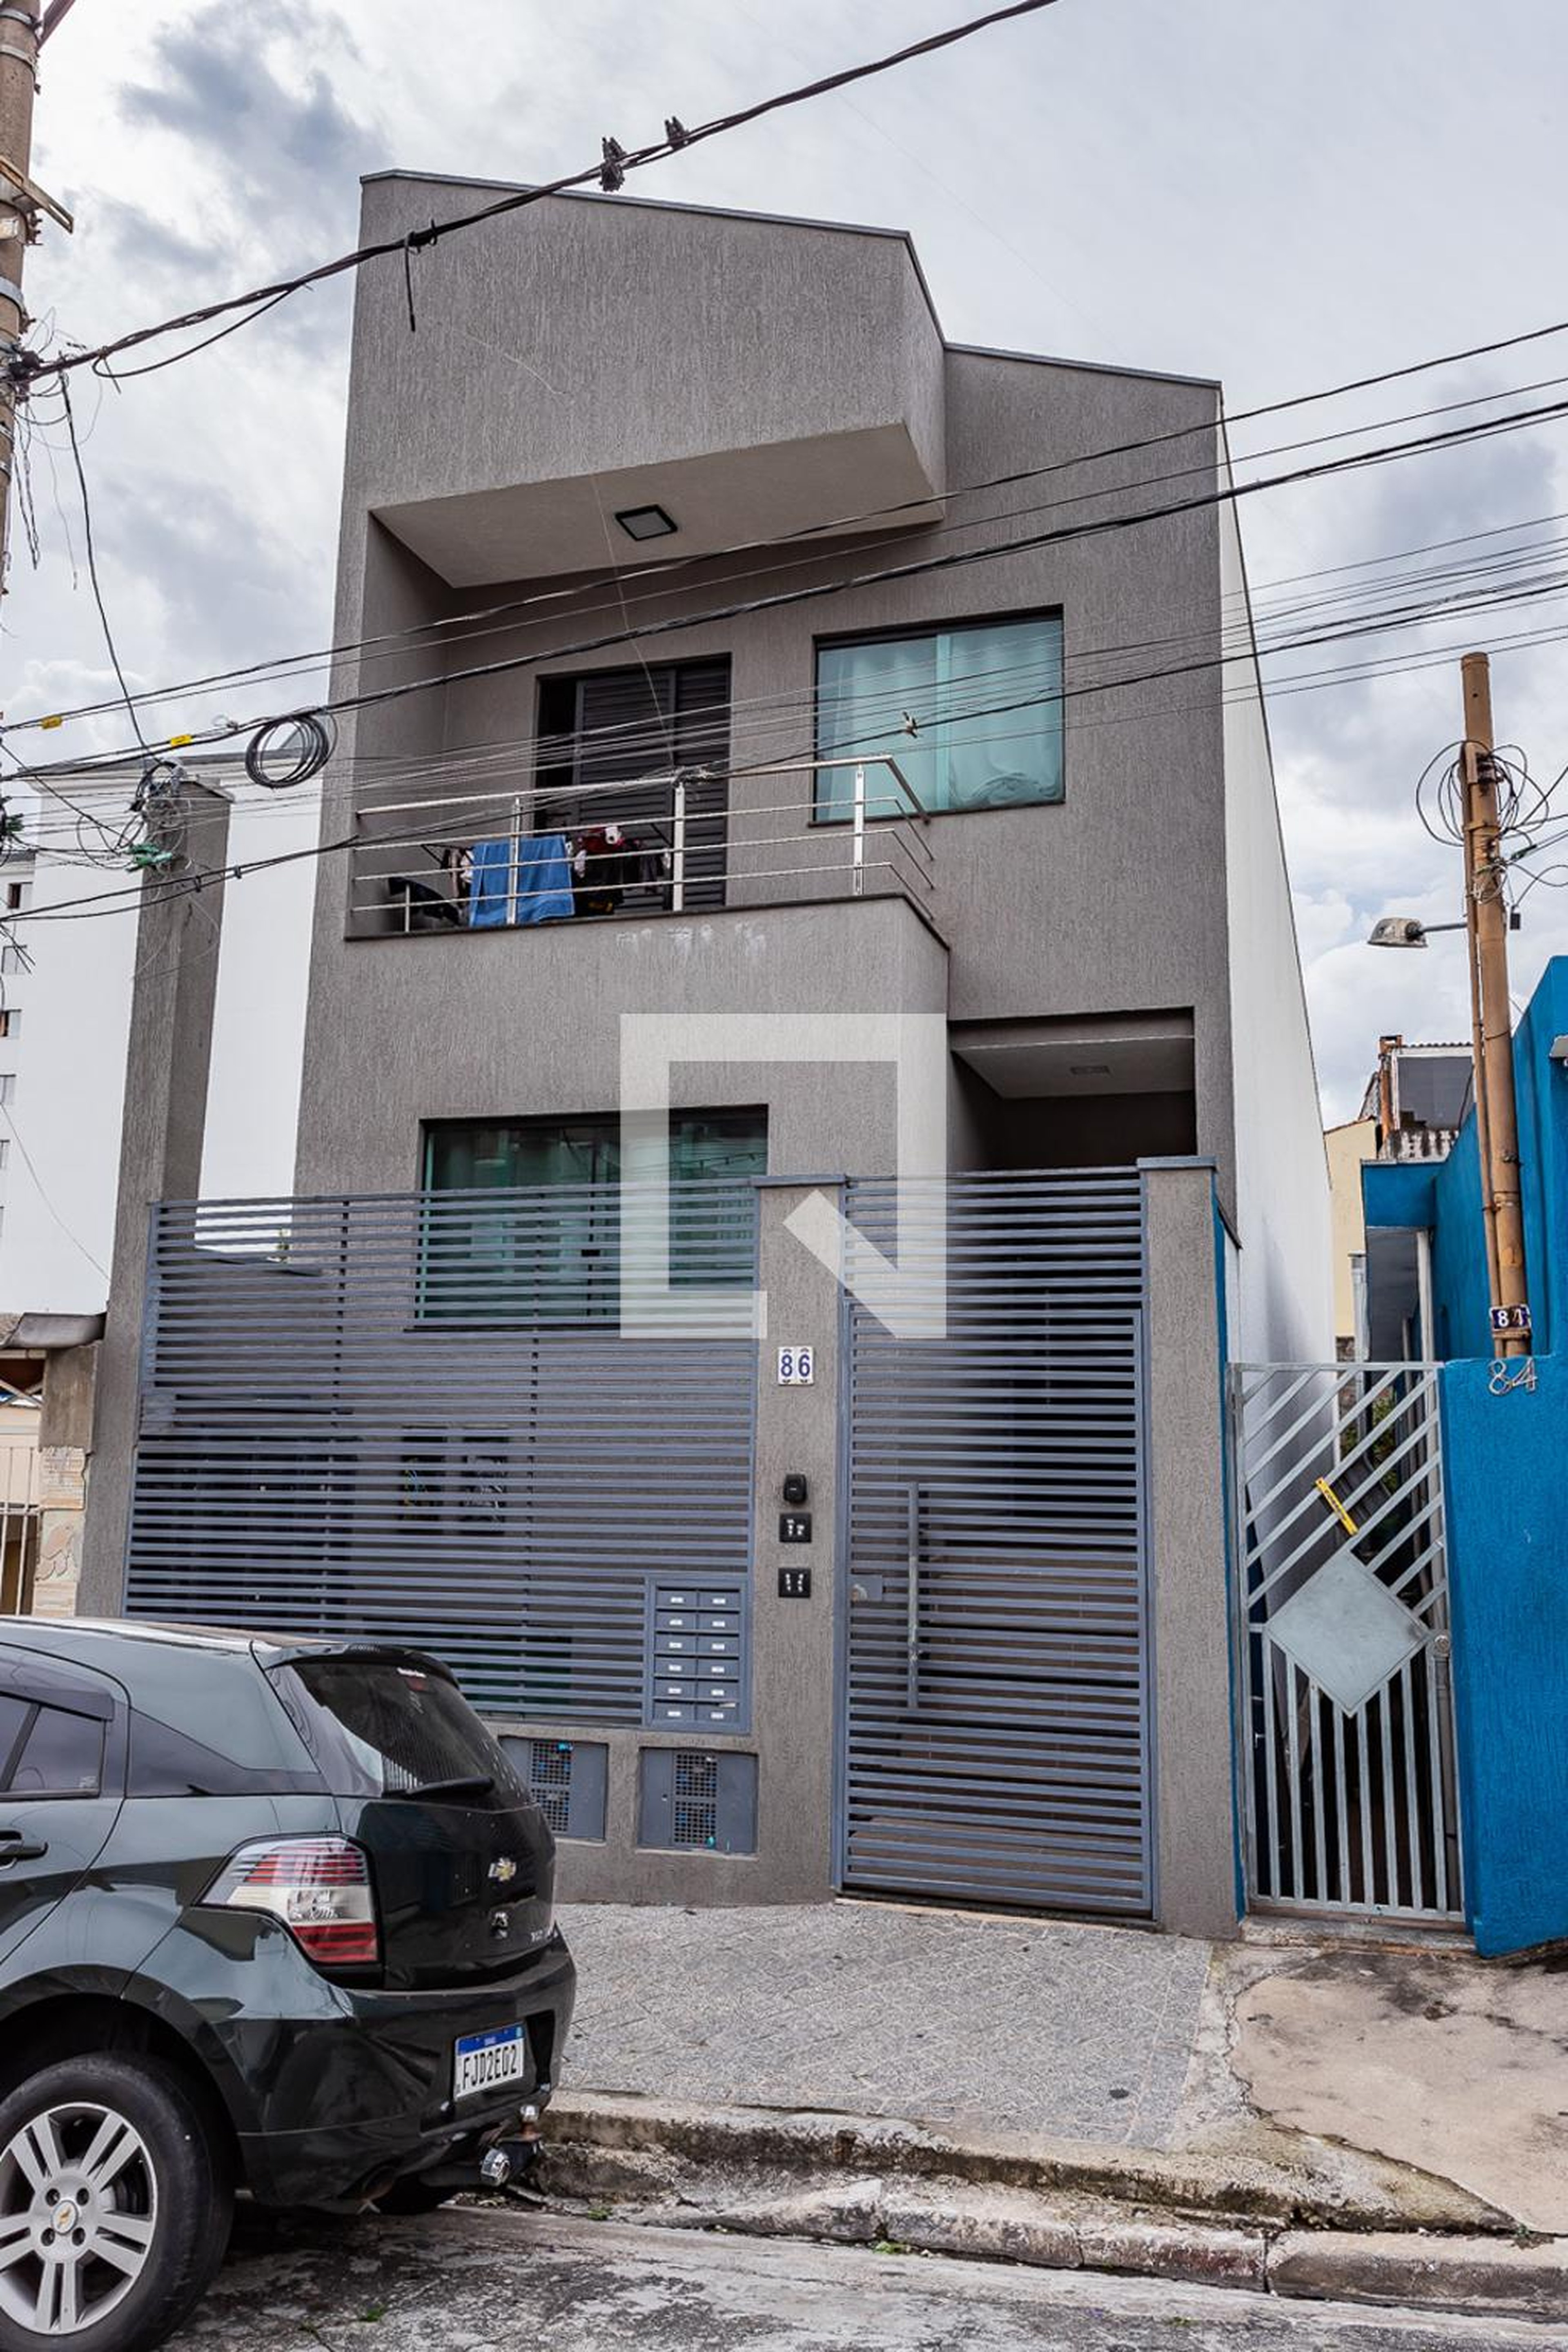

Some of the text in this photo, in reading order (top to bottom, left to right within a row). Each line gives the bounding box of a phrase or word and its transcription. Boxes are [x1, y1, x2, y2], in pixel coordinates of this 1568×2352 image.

[781, 1354, 810, 1377] 86
[1488, 1358, 1538, 1394] 84
[462, 2043, 517, 2090] FJD2E02
